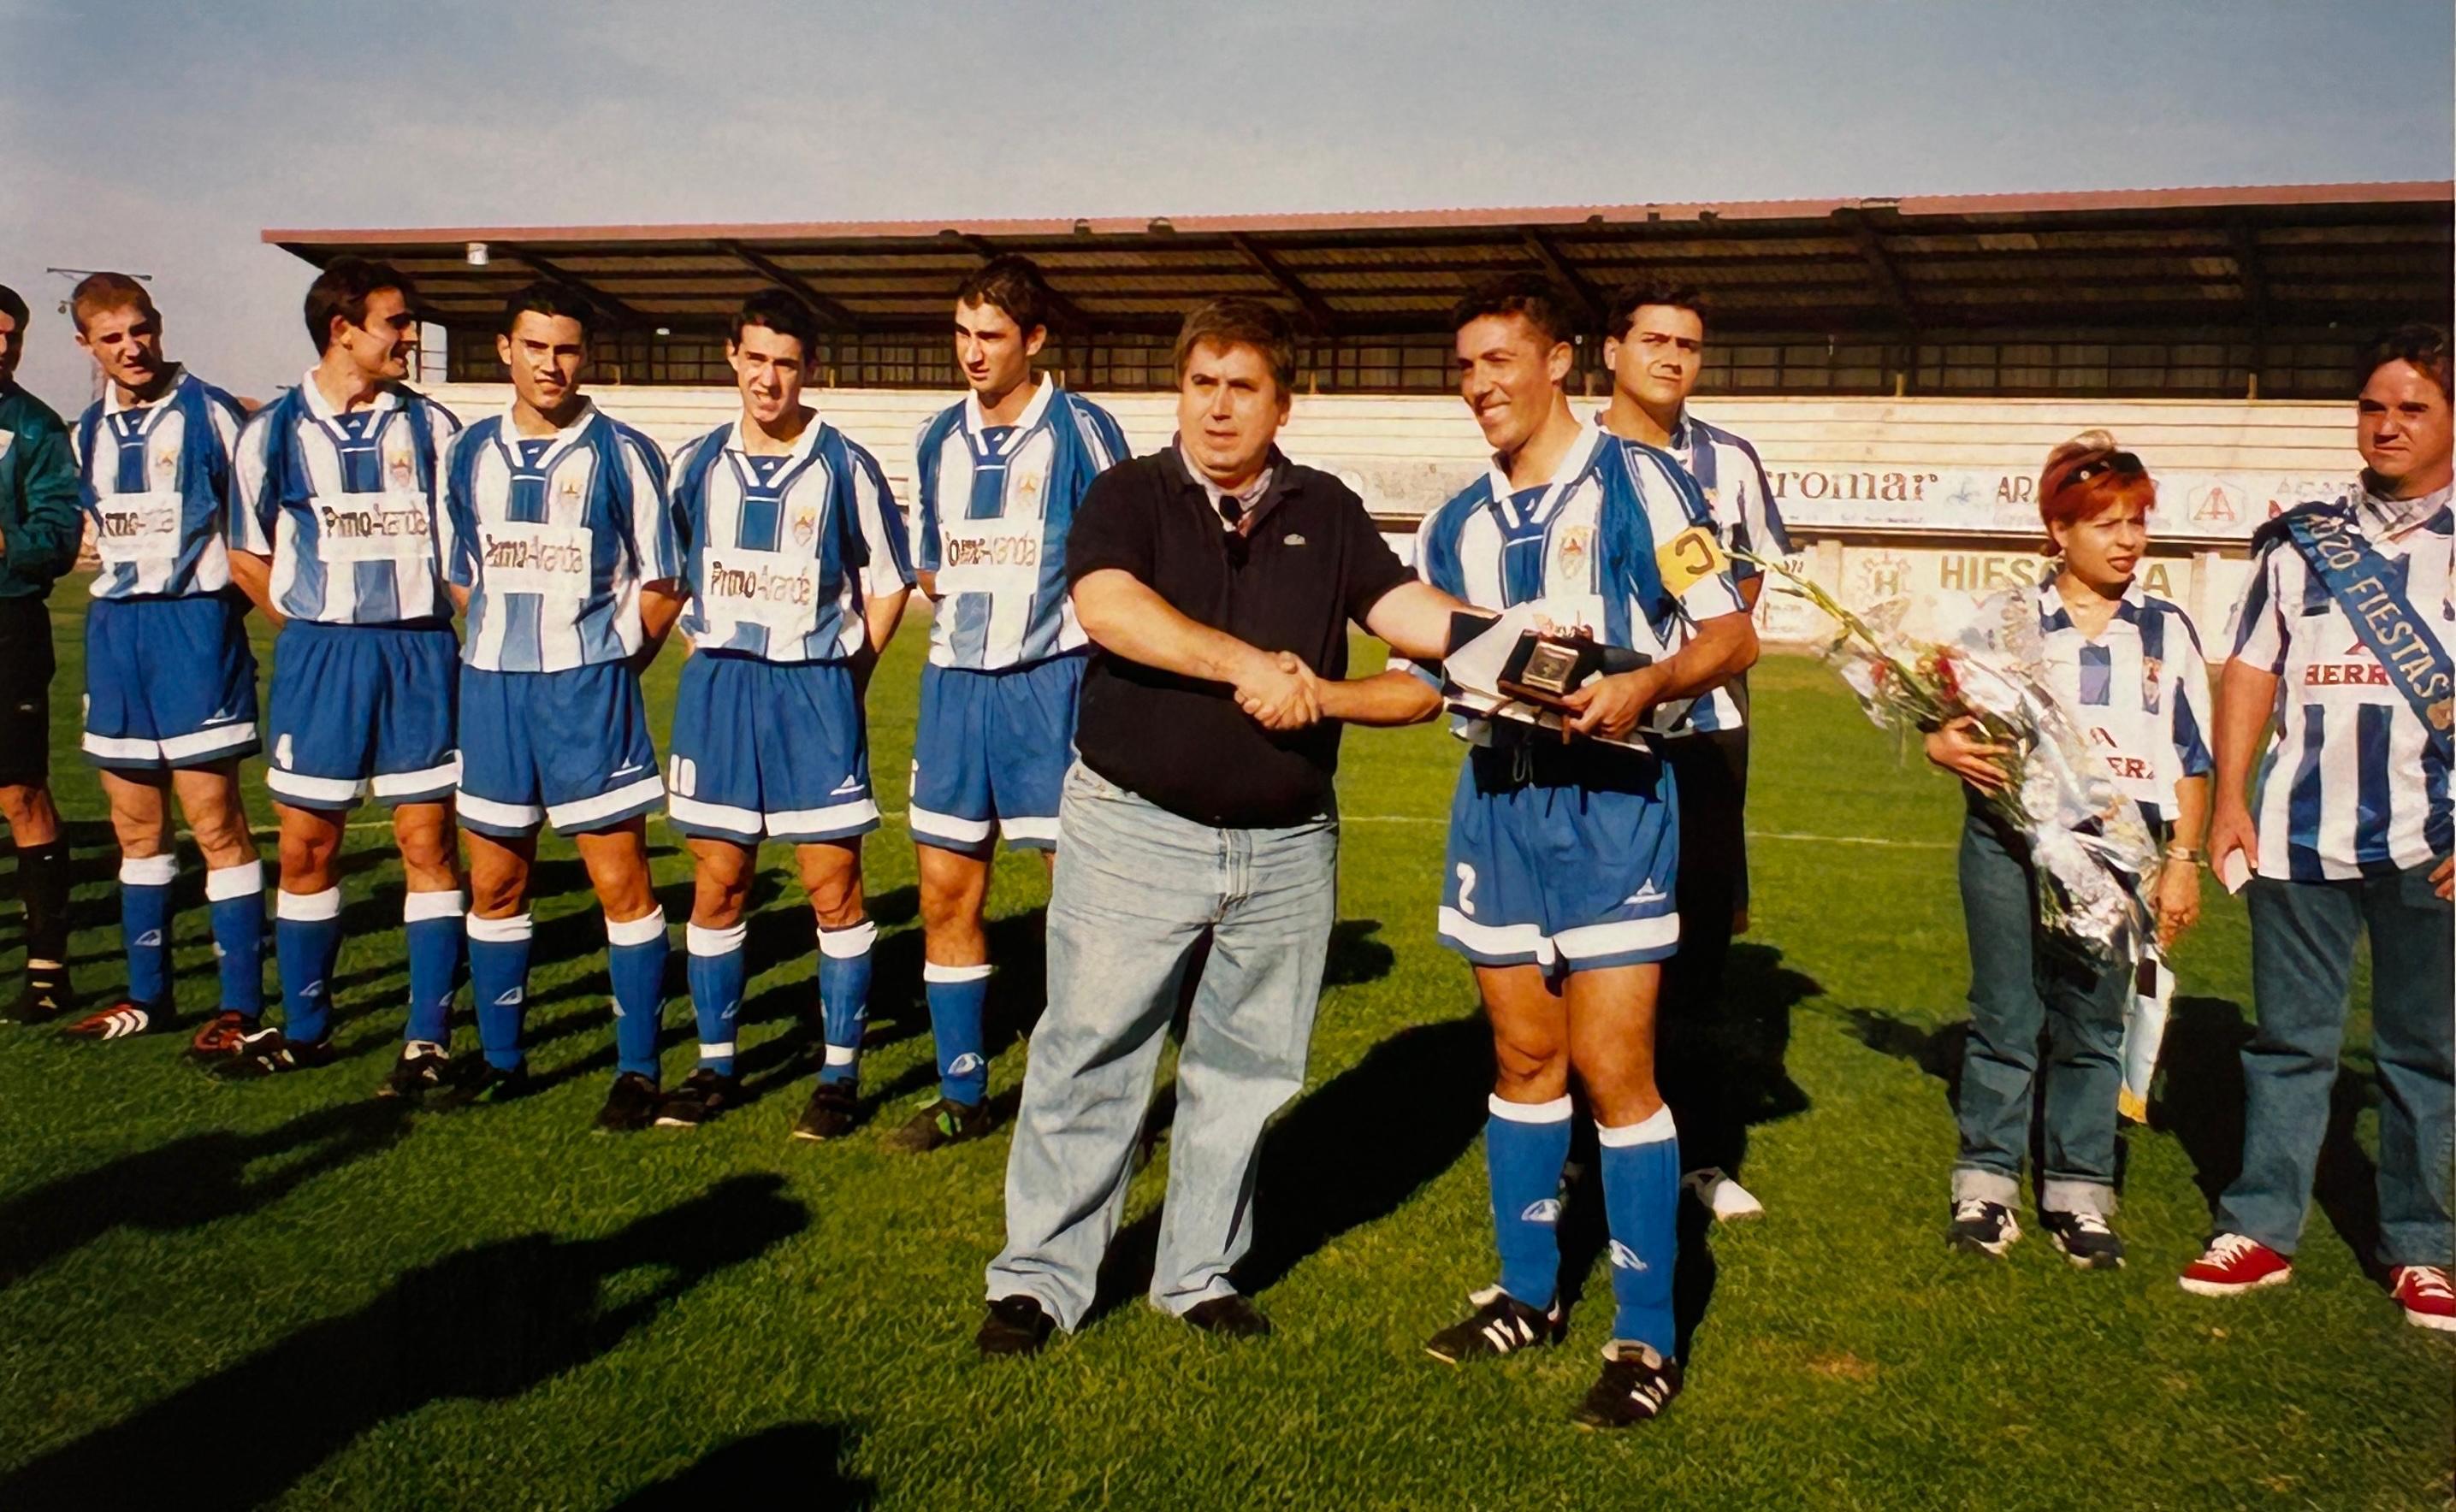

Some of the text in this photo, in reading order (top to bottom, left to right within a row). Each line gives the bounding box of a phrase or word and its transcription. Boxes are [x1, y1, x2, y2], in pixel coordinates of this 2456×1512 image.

[1765, 470, 1939, 501] romar
[2344, 576, 2450, 699] FIESTAS
[1456, 862, 1476, 915] 2
